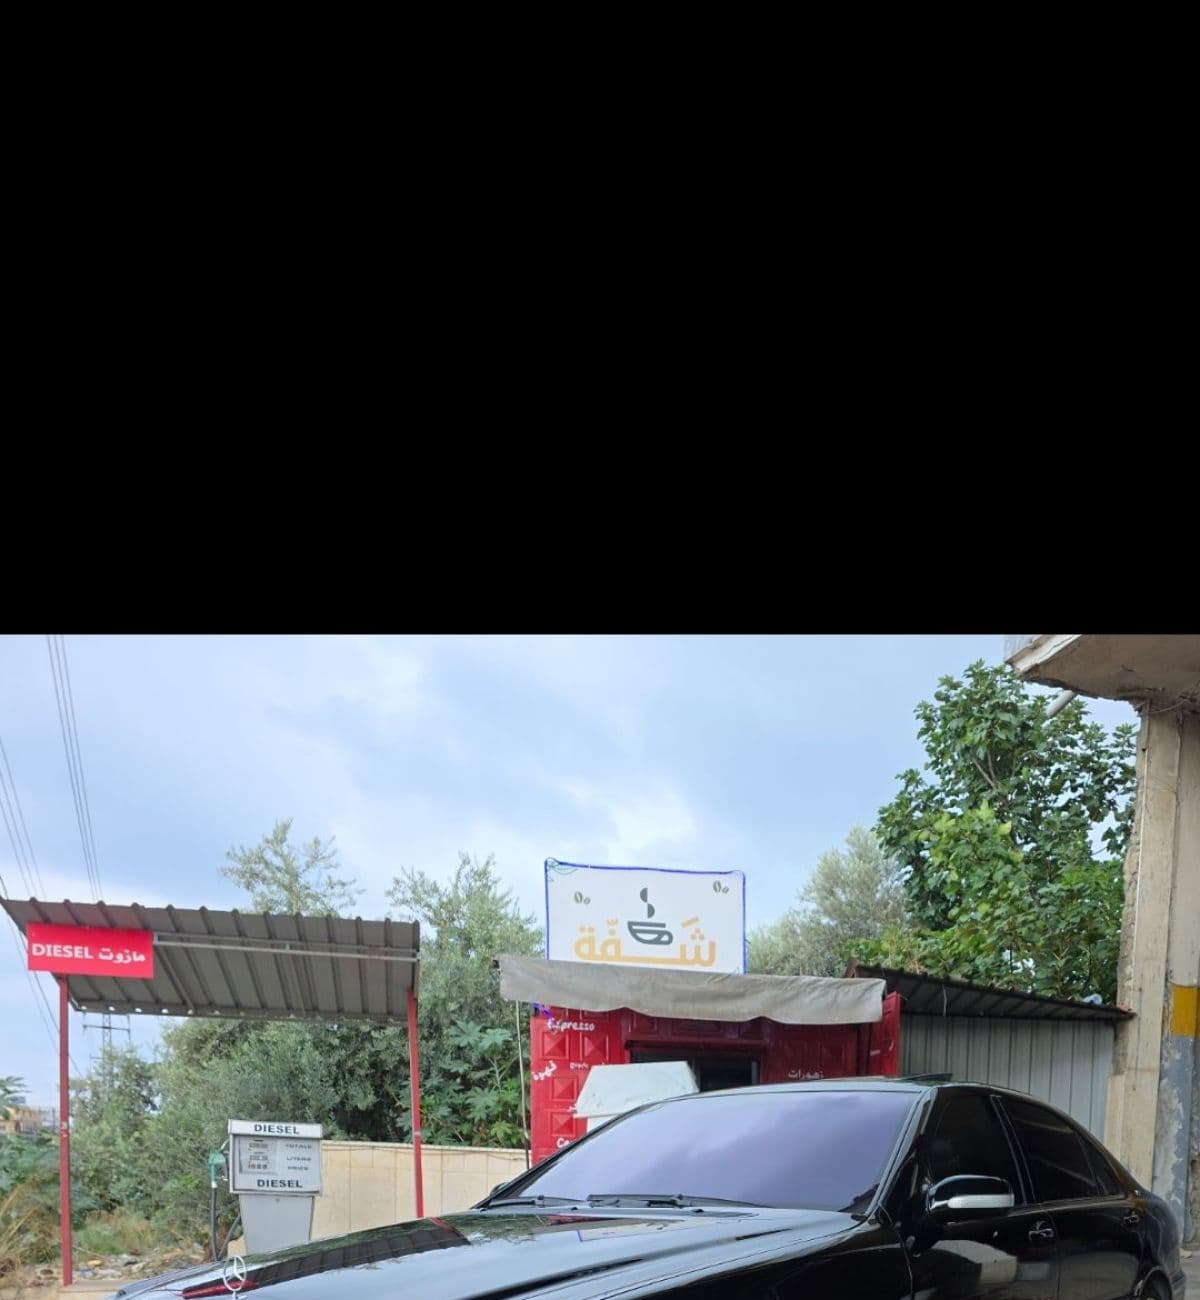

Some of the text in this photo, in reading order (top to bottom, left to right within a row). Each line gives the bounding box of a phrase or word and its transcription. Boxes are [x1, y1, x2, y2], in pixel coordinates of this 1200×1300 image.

[32, 943, 94, 960] DIESEL
[98, 948, 146, 964] مازوت
[254, 1123, 300, 1135] DIESEL
[257, 1179, 303, 1188] DIESEL
